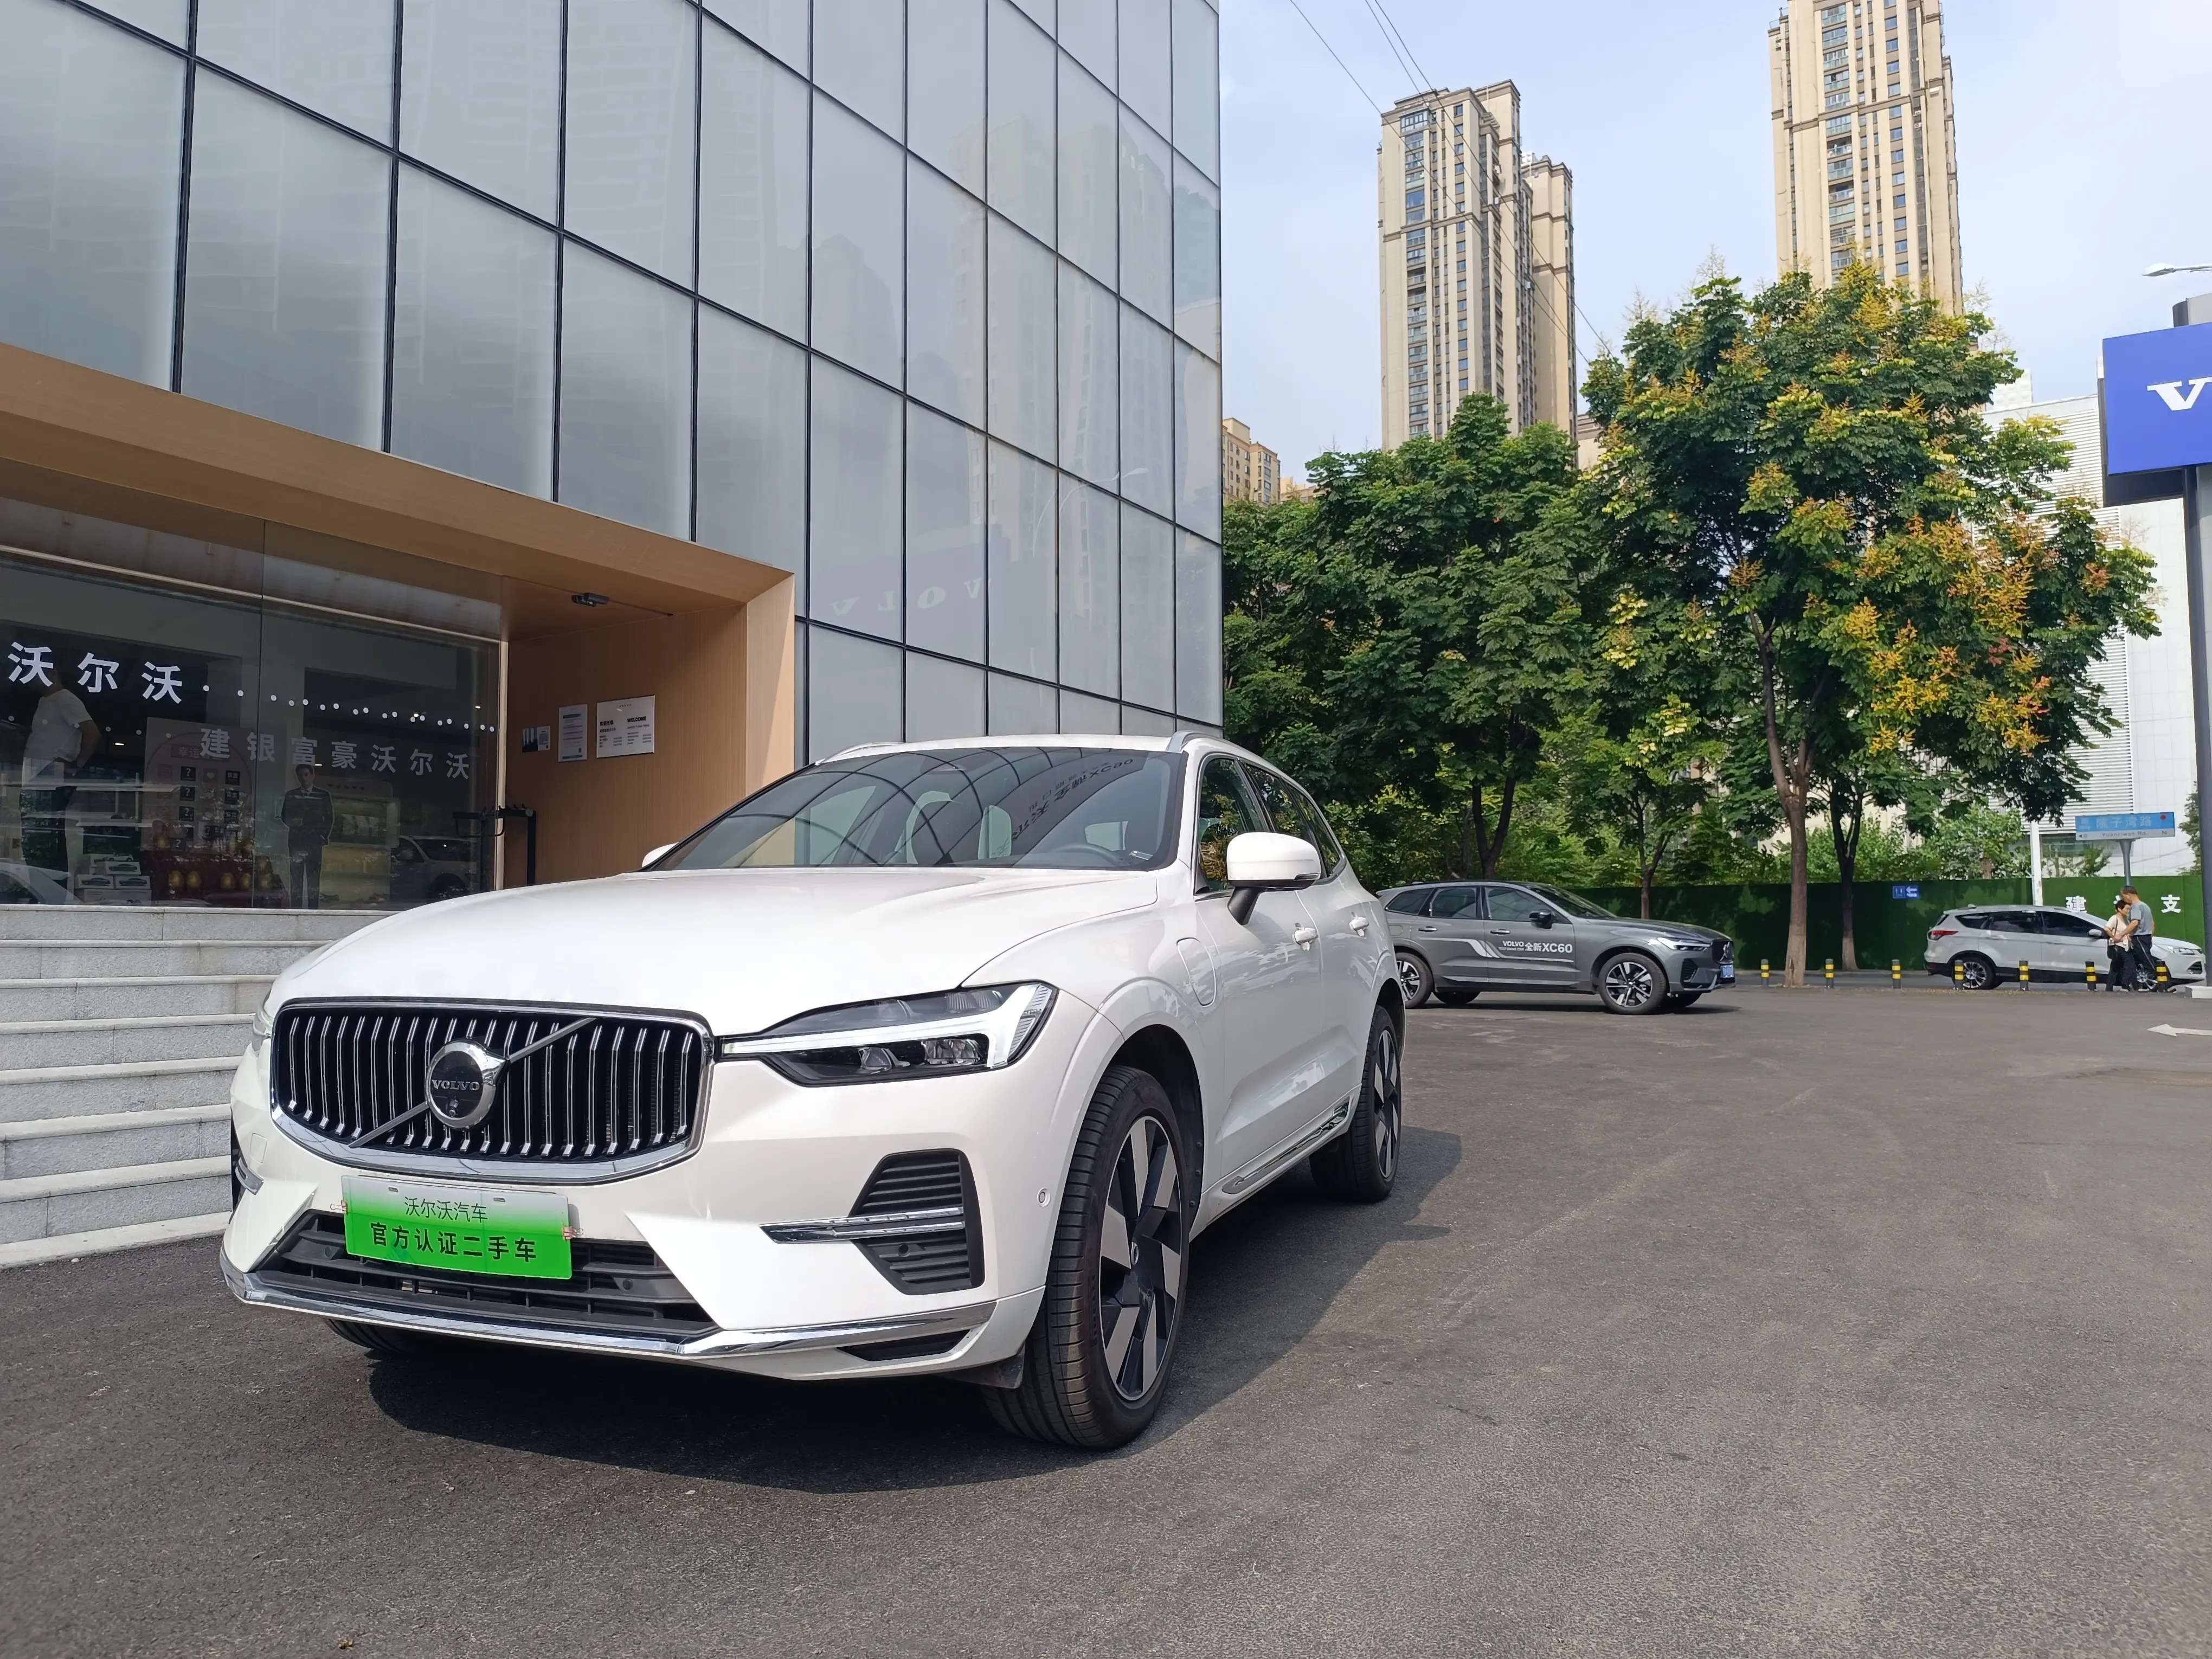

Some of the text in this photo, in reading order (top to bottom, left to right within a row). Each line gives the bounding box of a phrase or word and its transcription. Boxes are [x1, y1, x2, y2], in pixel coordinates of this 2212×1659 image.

[8, 641, 182, 704] 沃尔沃
[200, 728, 470, 780] 建银富豪沃尔沃
[1525, 942, 1573, 953] 全新XC60
[432, 1079, 480, 1091] VOLVO
[404, 1196, 488, 1223] 沃尔沃汽车
[370, 1221, 536, 1263] 官方认证二手车
